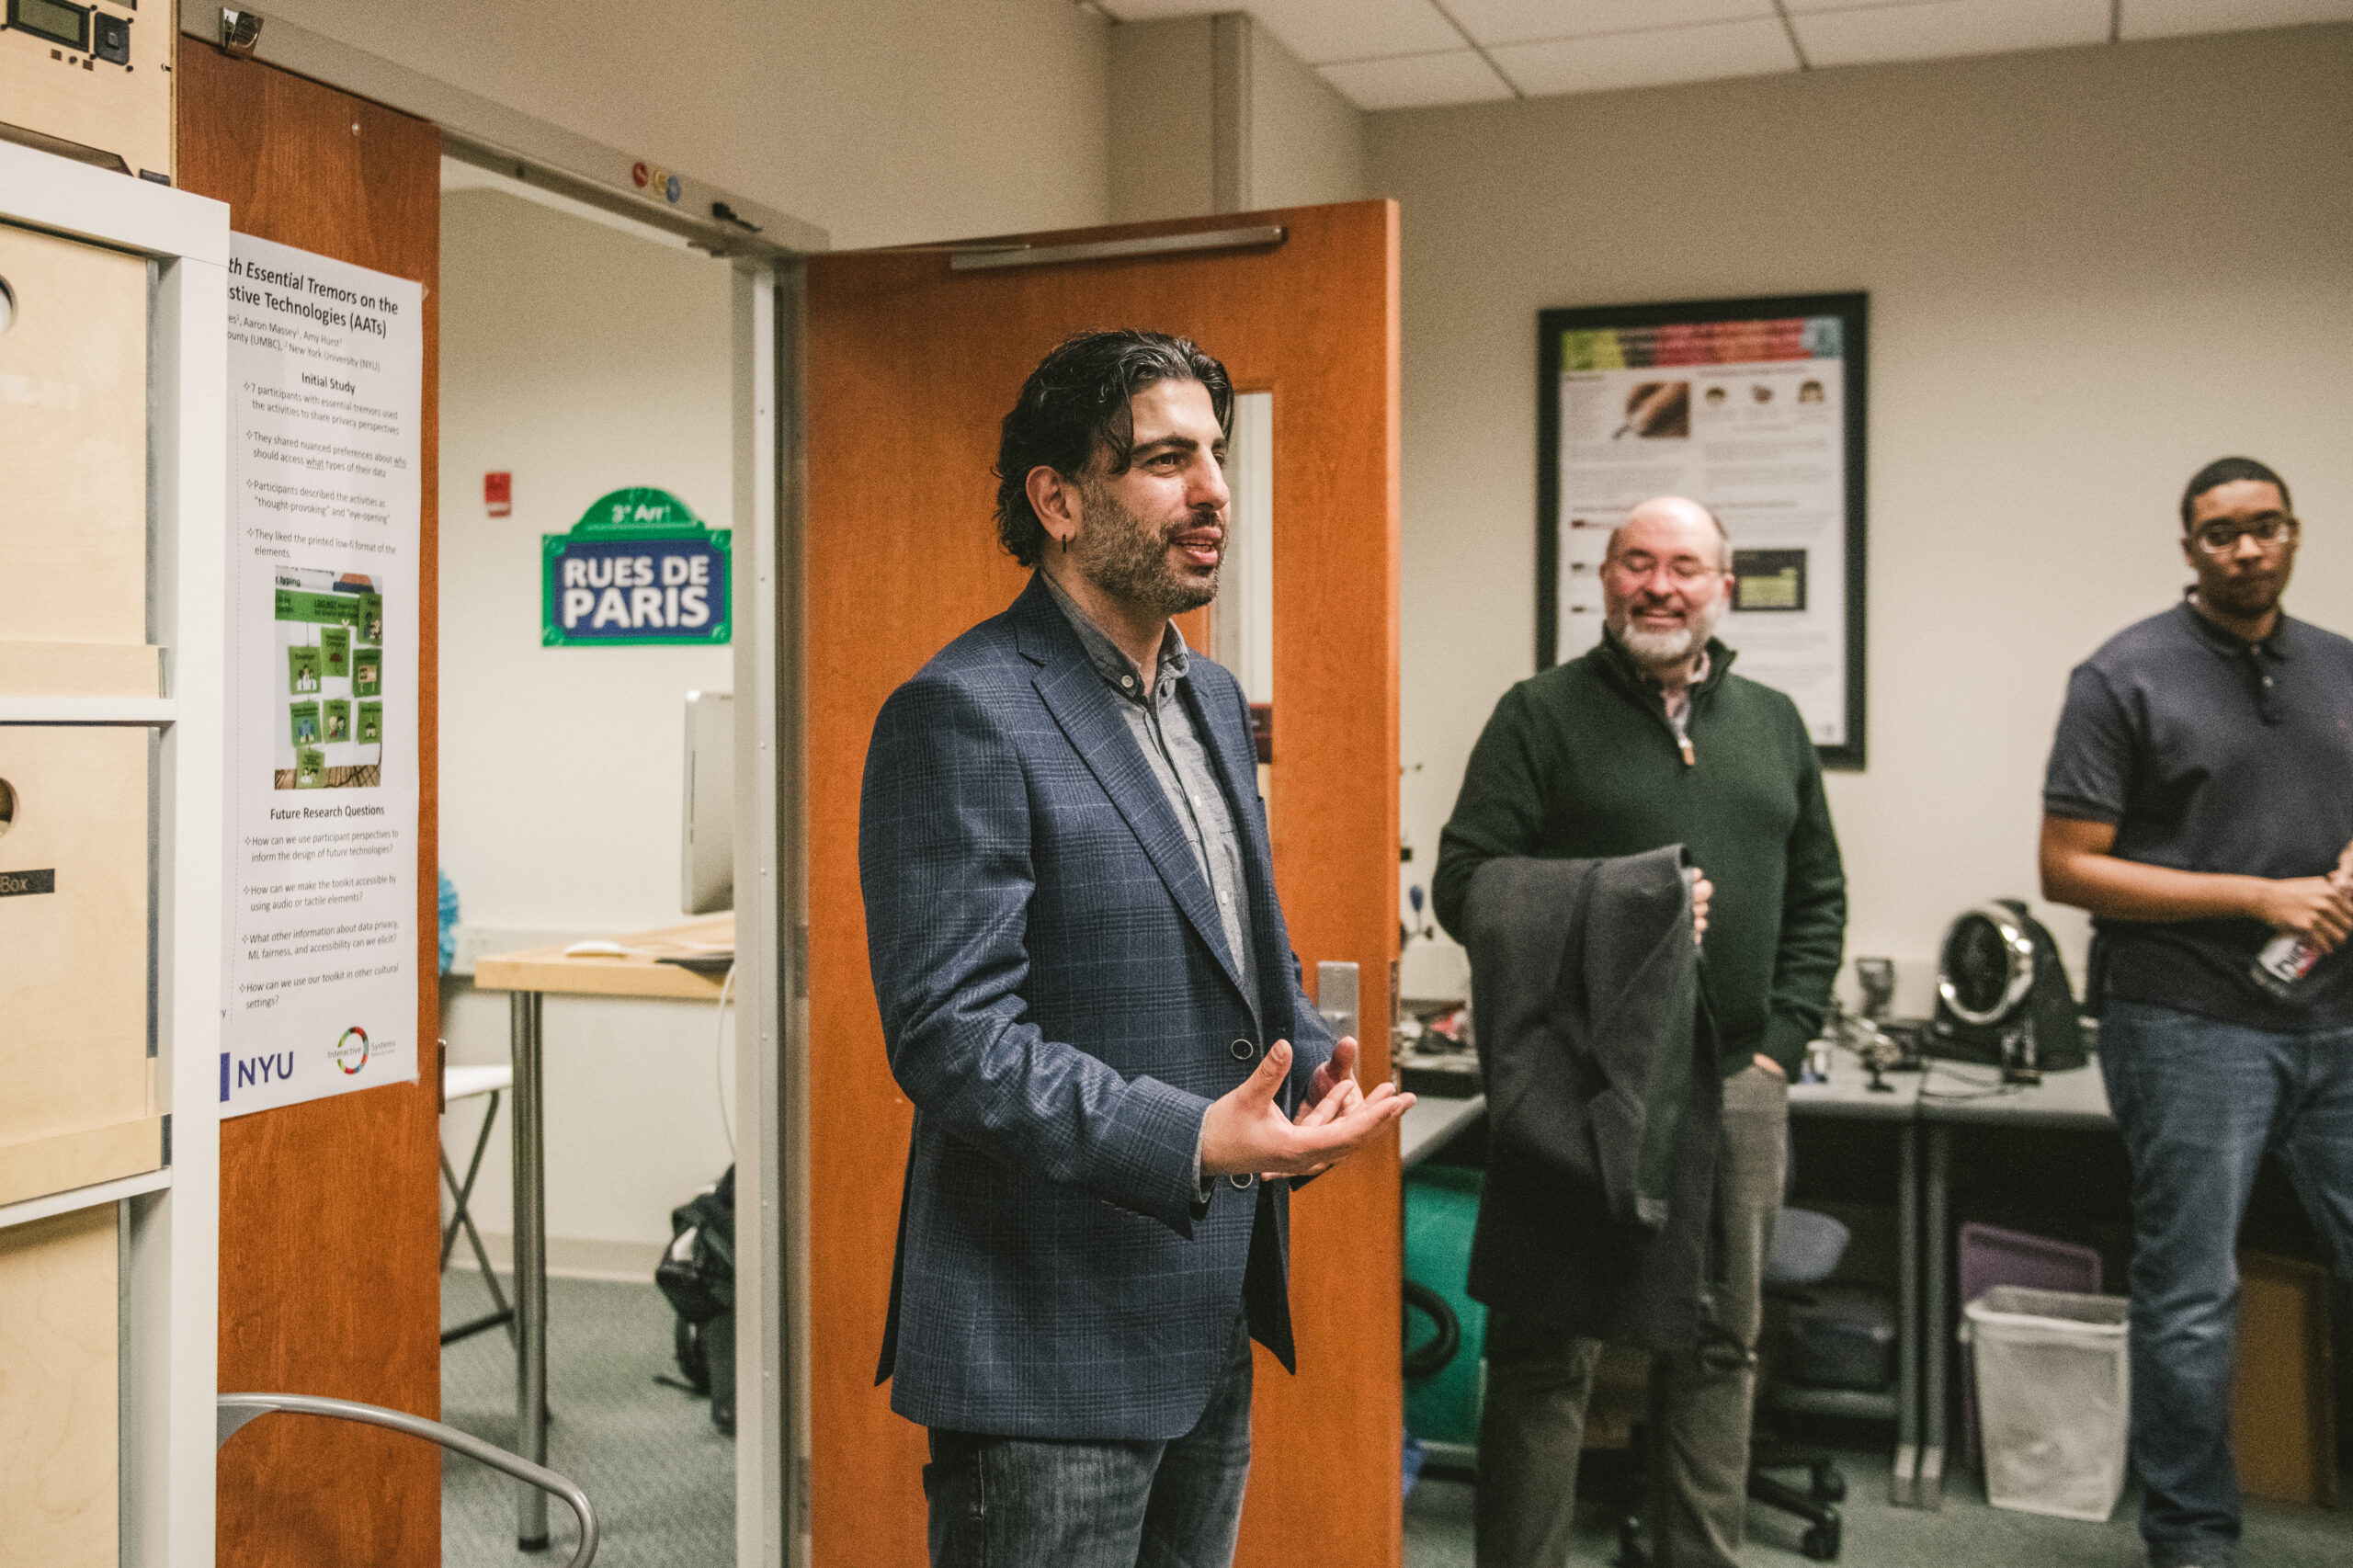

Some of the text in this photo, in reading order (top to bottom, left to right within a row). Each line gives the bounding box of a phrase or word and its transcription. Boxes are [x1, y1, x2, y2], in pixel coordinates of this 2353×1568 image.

[246, 262, 303, 291] Essential
[308, 278, 357, 304] Tremors
[360, 295, 375, 309] on
[380, 297, 398, 314] the
[230, 286, 386, 338] stive Technologies (AATs)
[244, 317, 267, 332] Aaron
[303, 332, 319, 343] Amy
[251, 334, 282, 352] (UMBC),
[289, 344, 305, 355] New
[308, 348, 322, 358] York
[324, 351, 358, 368] University
[359, 359, 381, 372] (NYU)
[302, 372, 355, 395] Initial Study
[258, 387, 302, 402] participants
[304, 394, 320, 403] with
[322, 397, 352, 411] essential
[354, 404, 381, 416] tremors
[383, 410, 398, 420] used
[253, 400, 399, 435] the activities to share privacy perspectives
[254, 432, 407, 468] They shared nuanced preferences about who
[254, 449, 386, 477] should access what types of their data
[254, 480, 298, 495] Participants
[300, 488, 335, 500] described
[336, 492, 347, 501] the
[350, 494, 377, 506] activities
[332, 507, 345, 517] and
[255, 529, 273, 541] They
[275, 531, 292, 541] liked
[294, 533, 306, 544] the
[309, 537, 334, 550] printed
[355, 541, 376, 551] format
[378, 544, 384, 552] of
[386, 545, 396, 555] the
[255, 547, 291, 558] elements.
[563, 555, 710, 587] RUES DE
[563, 586, 710, 629] PARIS
[270, 805, 384, 820] Future Research Questions
[252, 829, 399, 846] How can we use participant perspectives to
[252, 845, 392, 862] inform the design of future technologies?
[0, 875, 28, 893] Box
[251, 875, 396, 895] How can we make the toolkit accessible by
[251, 892, 363, 913] using audio or tactile elements?
[250, 934, 269, 943] What
[271, 931, 290, 941] other
[293, 926, 335, 938] information
[336, 924, 357, 934] about
[358, 922, 373, 932] data
[248, 934, 396, 960] ML fairness, and accessibility can we elicit?
[246, 963, 399, 993] How can we use our toolkit in other cultural
[245, 995, 279, 1009] settings?
[327, 1046, 361, 1059] Interactive
[371, 1040, 395, 1051] Systems
[238, 1051, 293, 1087] NYU
